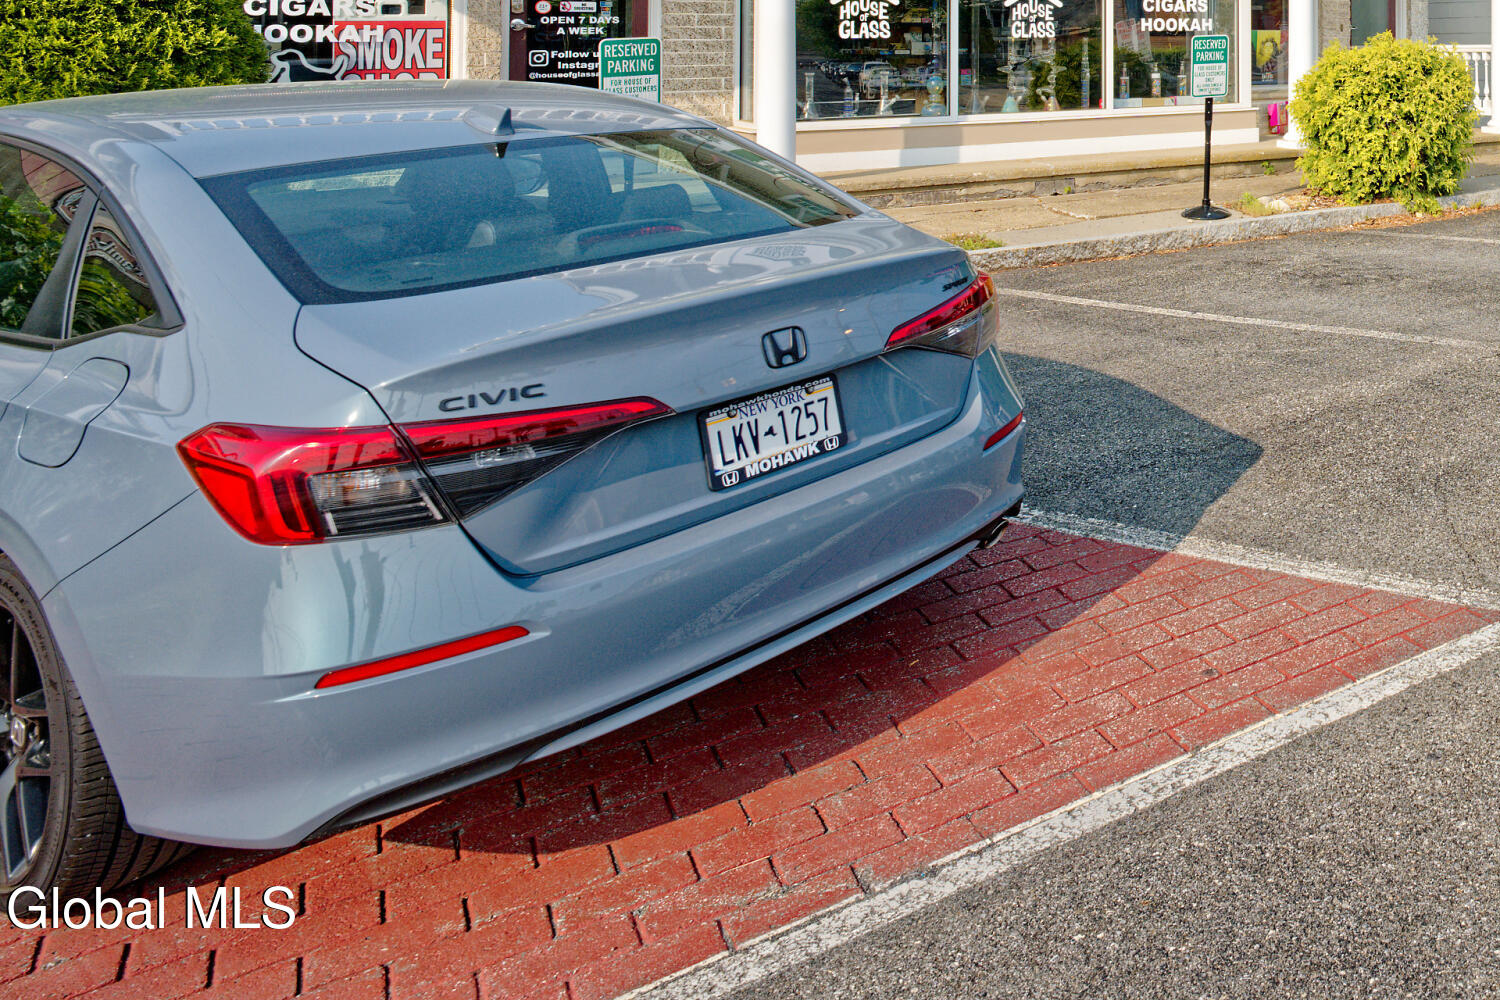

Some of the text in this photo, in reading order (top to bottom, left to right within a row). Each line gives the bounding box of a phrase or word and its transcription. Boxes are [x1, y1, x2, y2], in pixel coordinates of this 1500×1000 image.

[540, 16, 620, 24] OPEN 7 DAYS
[1141, 18, 1213, 32] HOOKAH
[254, 24, 384, 44] OOKAH
[556, 27, 605, 35] A WEEK
[839, 20, 892, 39] GLASS
[1012, 20, 1056, 39] GLASS
[339, 27, 444, 72] SMOKE
[604, 43, 657, 57] RESERVED
[1194, 39, 1226, 49] RESERVED
[551, 50, 590, 58] Follow
[1196, 51, 1225, 62] PARKING
[558, 61, 599, 70] Instagr
[608, 58, 655, 73] PARKING
[624, 78, 642, 86] HOUSE
[625, 85, 658, 94] CUSTOMERS
[439, 383, 546, 412] CIVIC
[708, 377, 831, 417] mohawkhonda.com
[738, 389, 805, 420] NEW YORK
[717, 396, 829, 467] LKV 1257
[745, 441, 821, 479] MOHAWK
